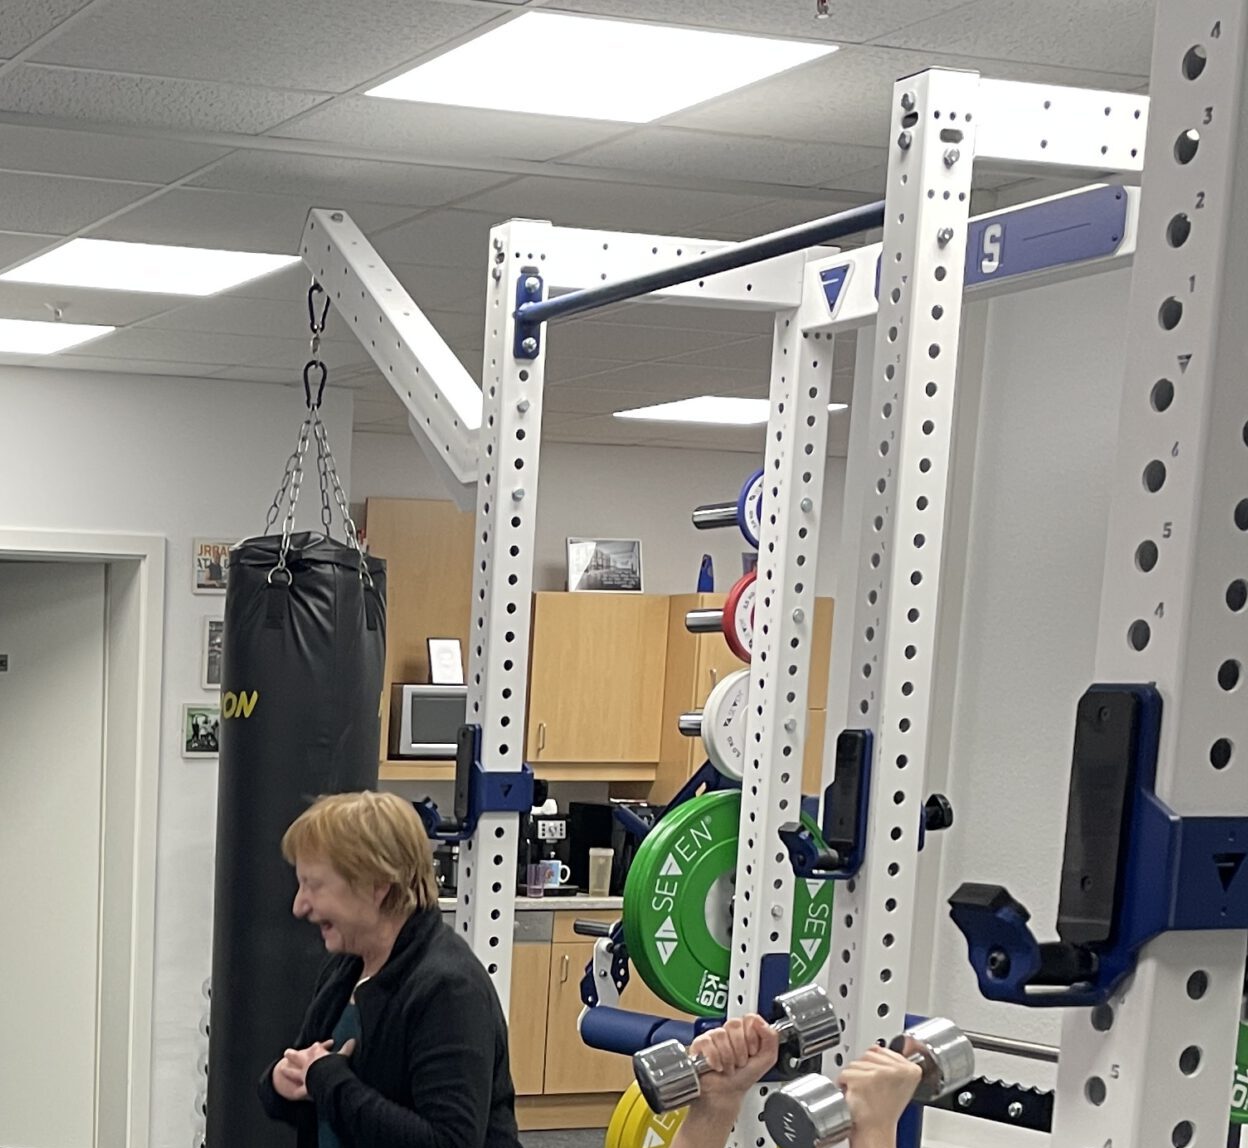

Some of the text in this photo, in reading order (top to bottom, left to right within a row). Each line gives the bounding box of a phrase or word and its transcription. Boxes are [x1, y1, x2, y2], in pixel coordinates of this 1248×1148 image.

[1202, 106, 1213, 124] 3
[1195, 191, 1205, 209] 2
[981, 223, 1002, 274] S
[1188, 275, 1196, 293] 1
[1171, 441, 1179, 457] 6
[1162, 522, 1172, 538] 5
[222, 691, 259, 719] ON
[1110, 1064, 1120, 1079] 5
